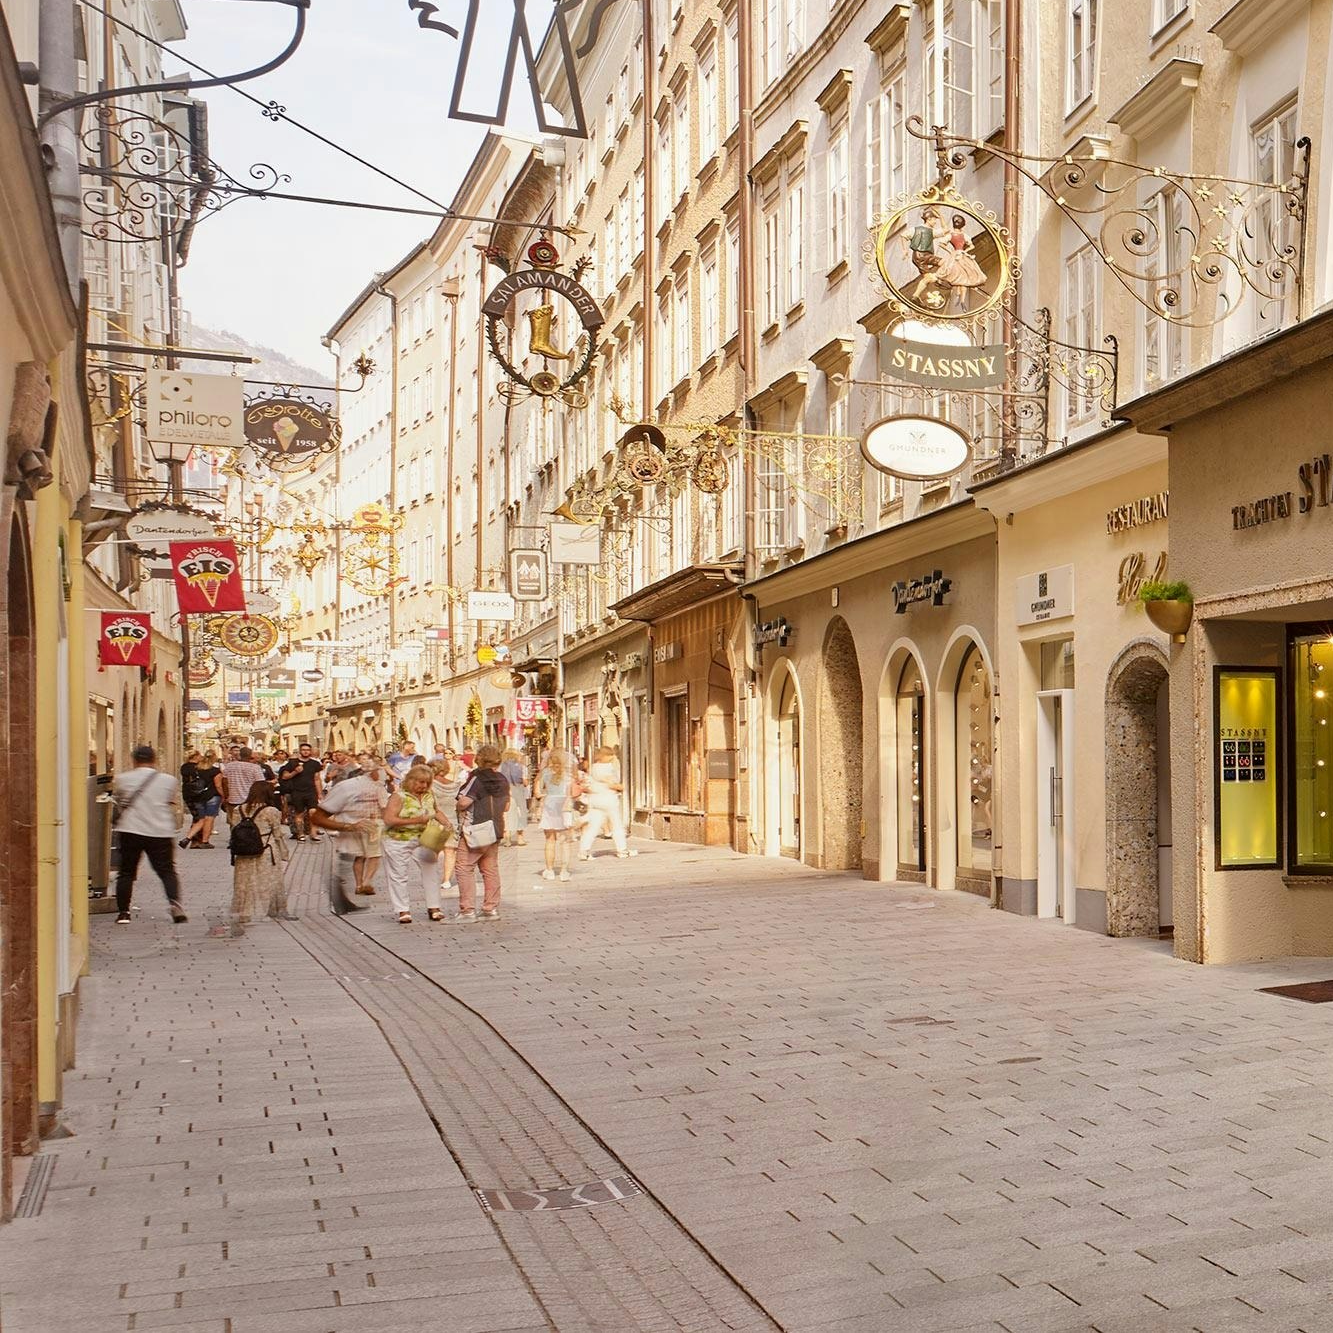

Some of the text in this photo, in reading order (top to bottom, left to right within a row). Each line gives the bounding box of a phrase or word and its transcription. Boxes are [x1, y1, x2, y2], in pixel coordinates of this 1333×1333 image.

[491, 272, 596, 315] SALAMANDER
[891, 348, 996, 379] STASSNY
[159, 410, 232, 428] philoro
[257, 436, 317, 447] seit 1958
[1106, 490, 1169, 535] RESTAURAN
[1231, 491, 1292, 530] TRACHTEN
[187, 546, 223, 559] FRISCH
[180, 559, 232, 576] EIS
[473, 600, 510, 608] GEOX
[106, 627, 146, 639] EIS
